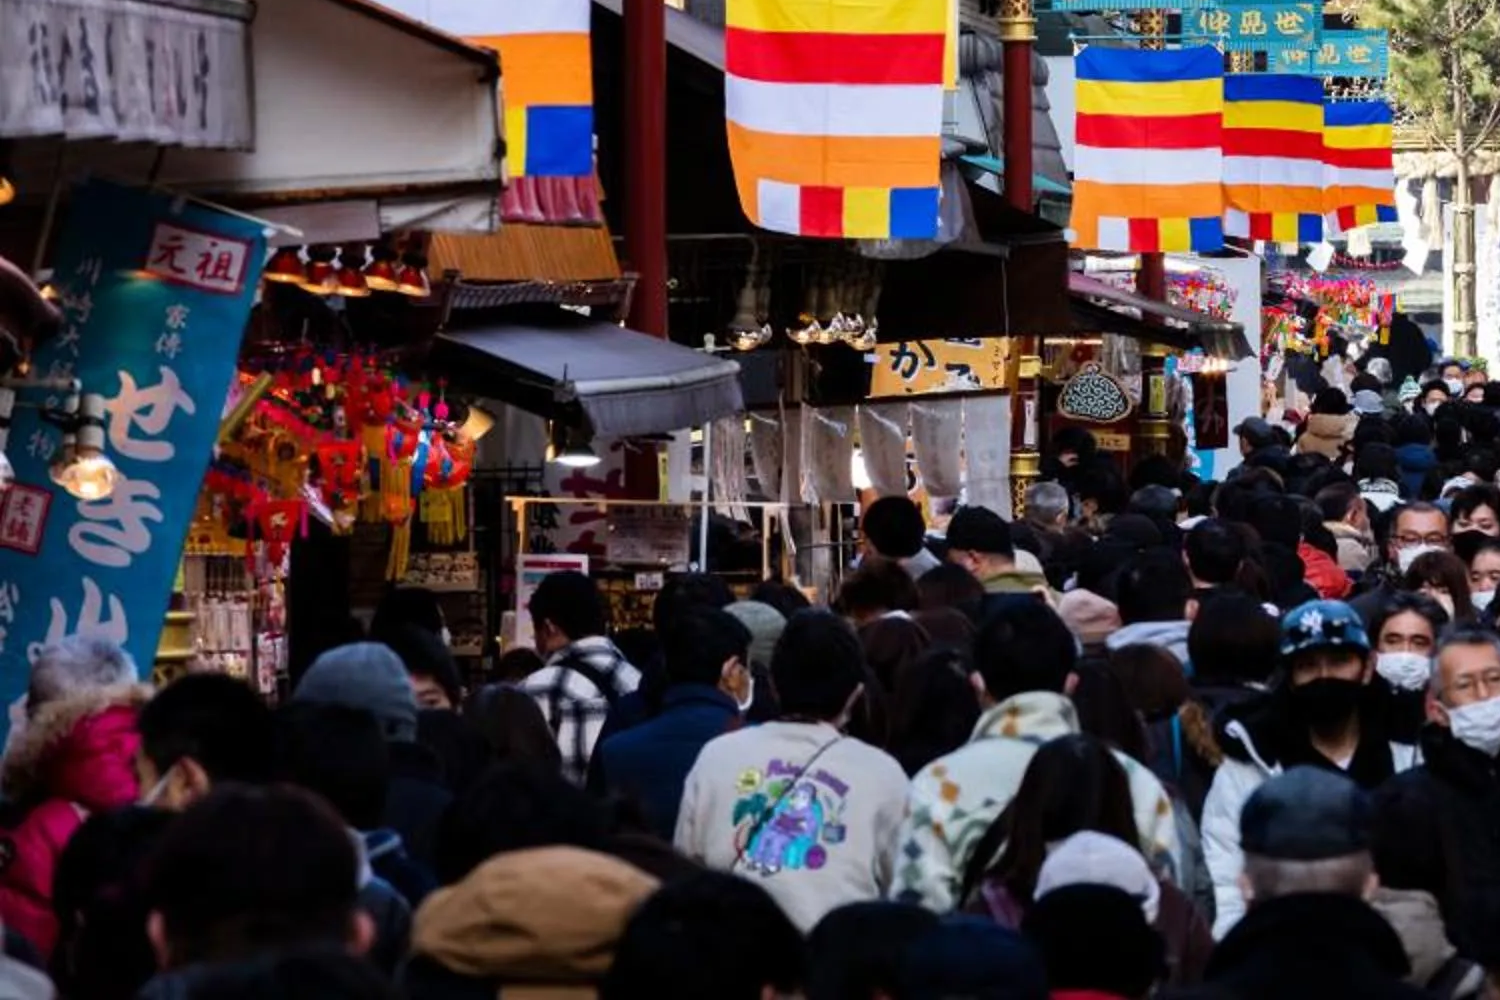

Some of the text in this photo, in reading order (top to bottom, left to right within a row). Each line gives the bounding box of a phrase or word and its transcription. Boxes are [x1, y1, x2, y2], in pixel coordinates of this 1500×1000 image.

[1199, 9, 1305, 36] 仲見世
[1281, 44, 1372, 66] 仲見世
[150, 234, 235, 283] 元祖
